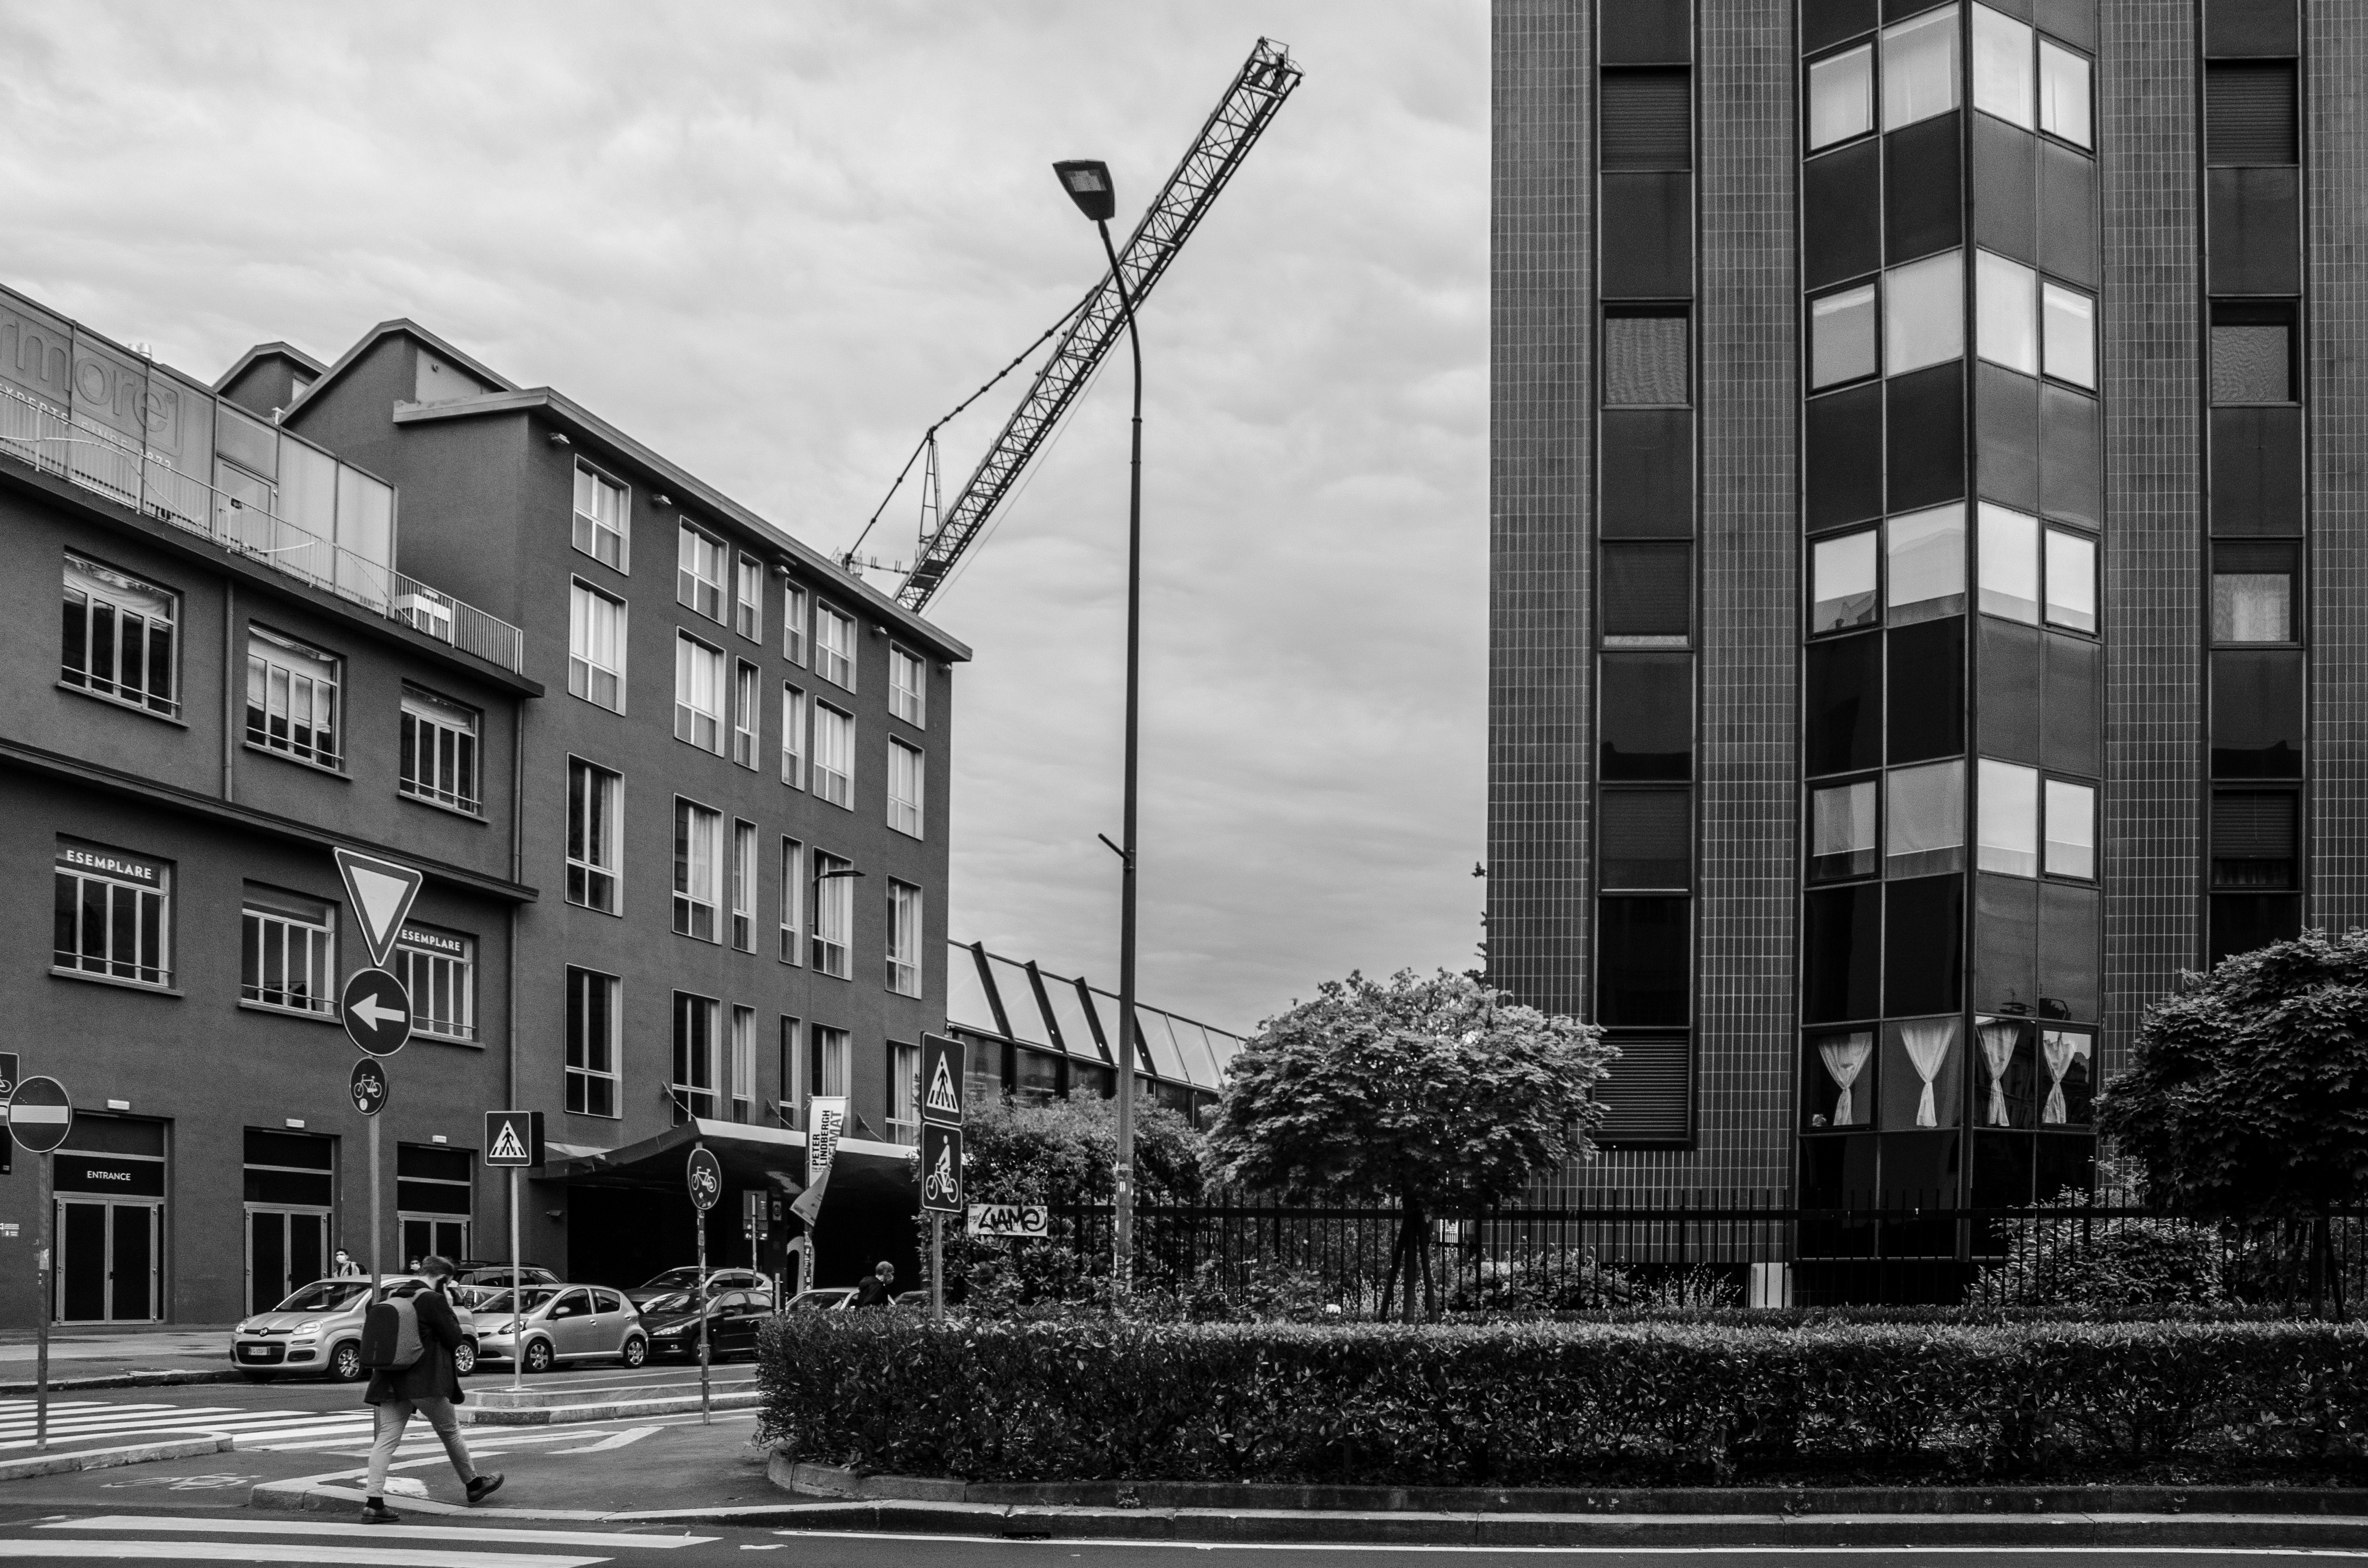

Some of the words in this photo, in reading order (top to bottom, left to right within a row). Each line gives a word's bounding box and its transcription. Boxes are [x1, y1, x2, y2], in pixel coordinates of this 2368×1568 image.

[0, 382, 69, 425] XPERTS
[67, 849, 151, 879] ESEMPLARE
[402, 929, 460, 951] ESEMPLARE
[820, 1110, 830, 1166] LINDBERGH
[87, 1171, 131, 1180] ENTRANCE
